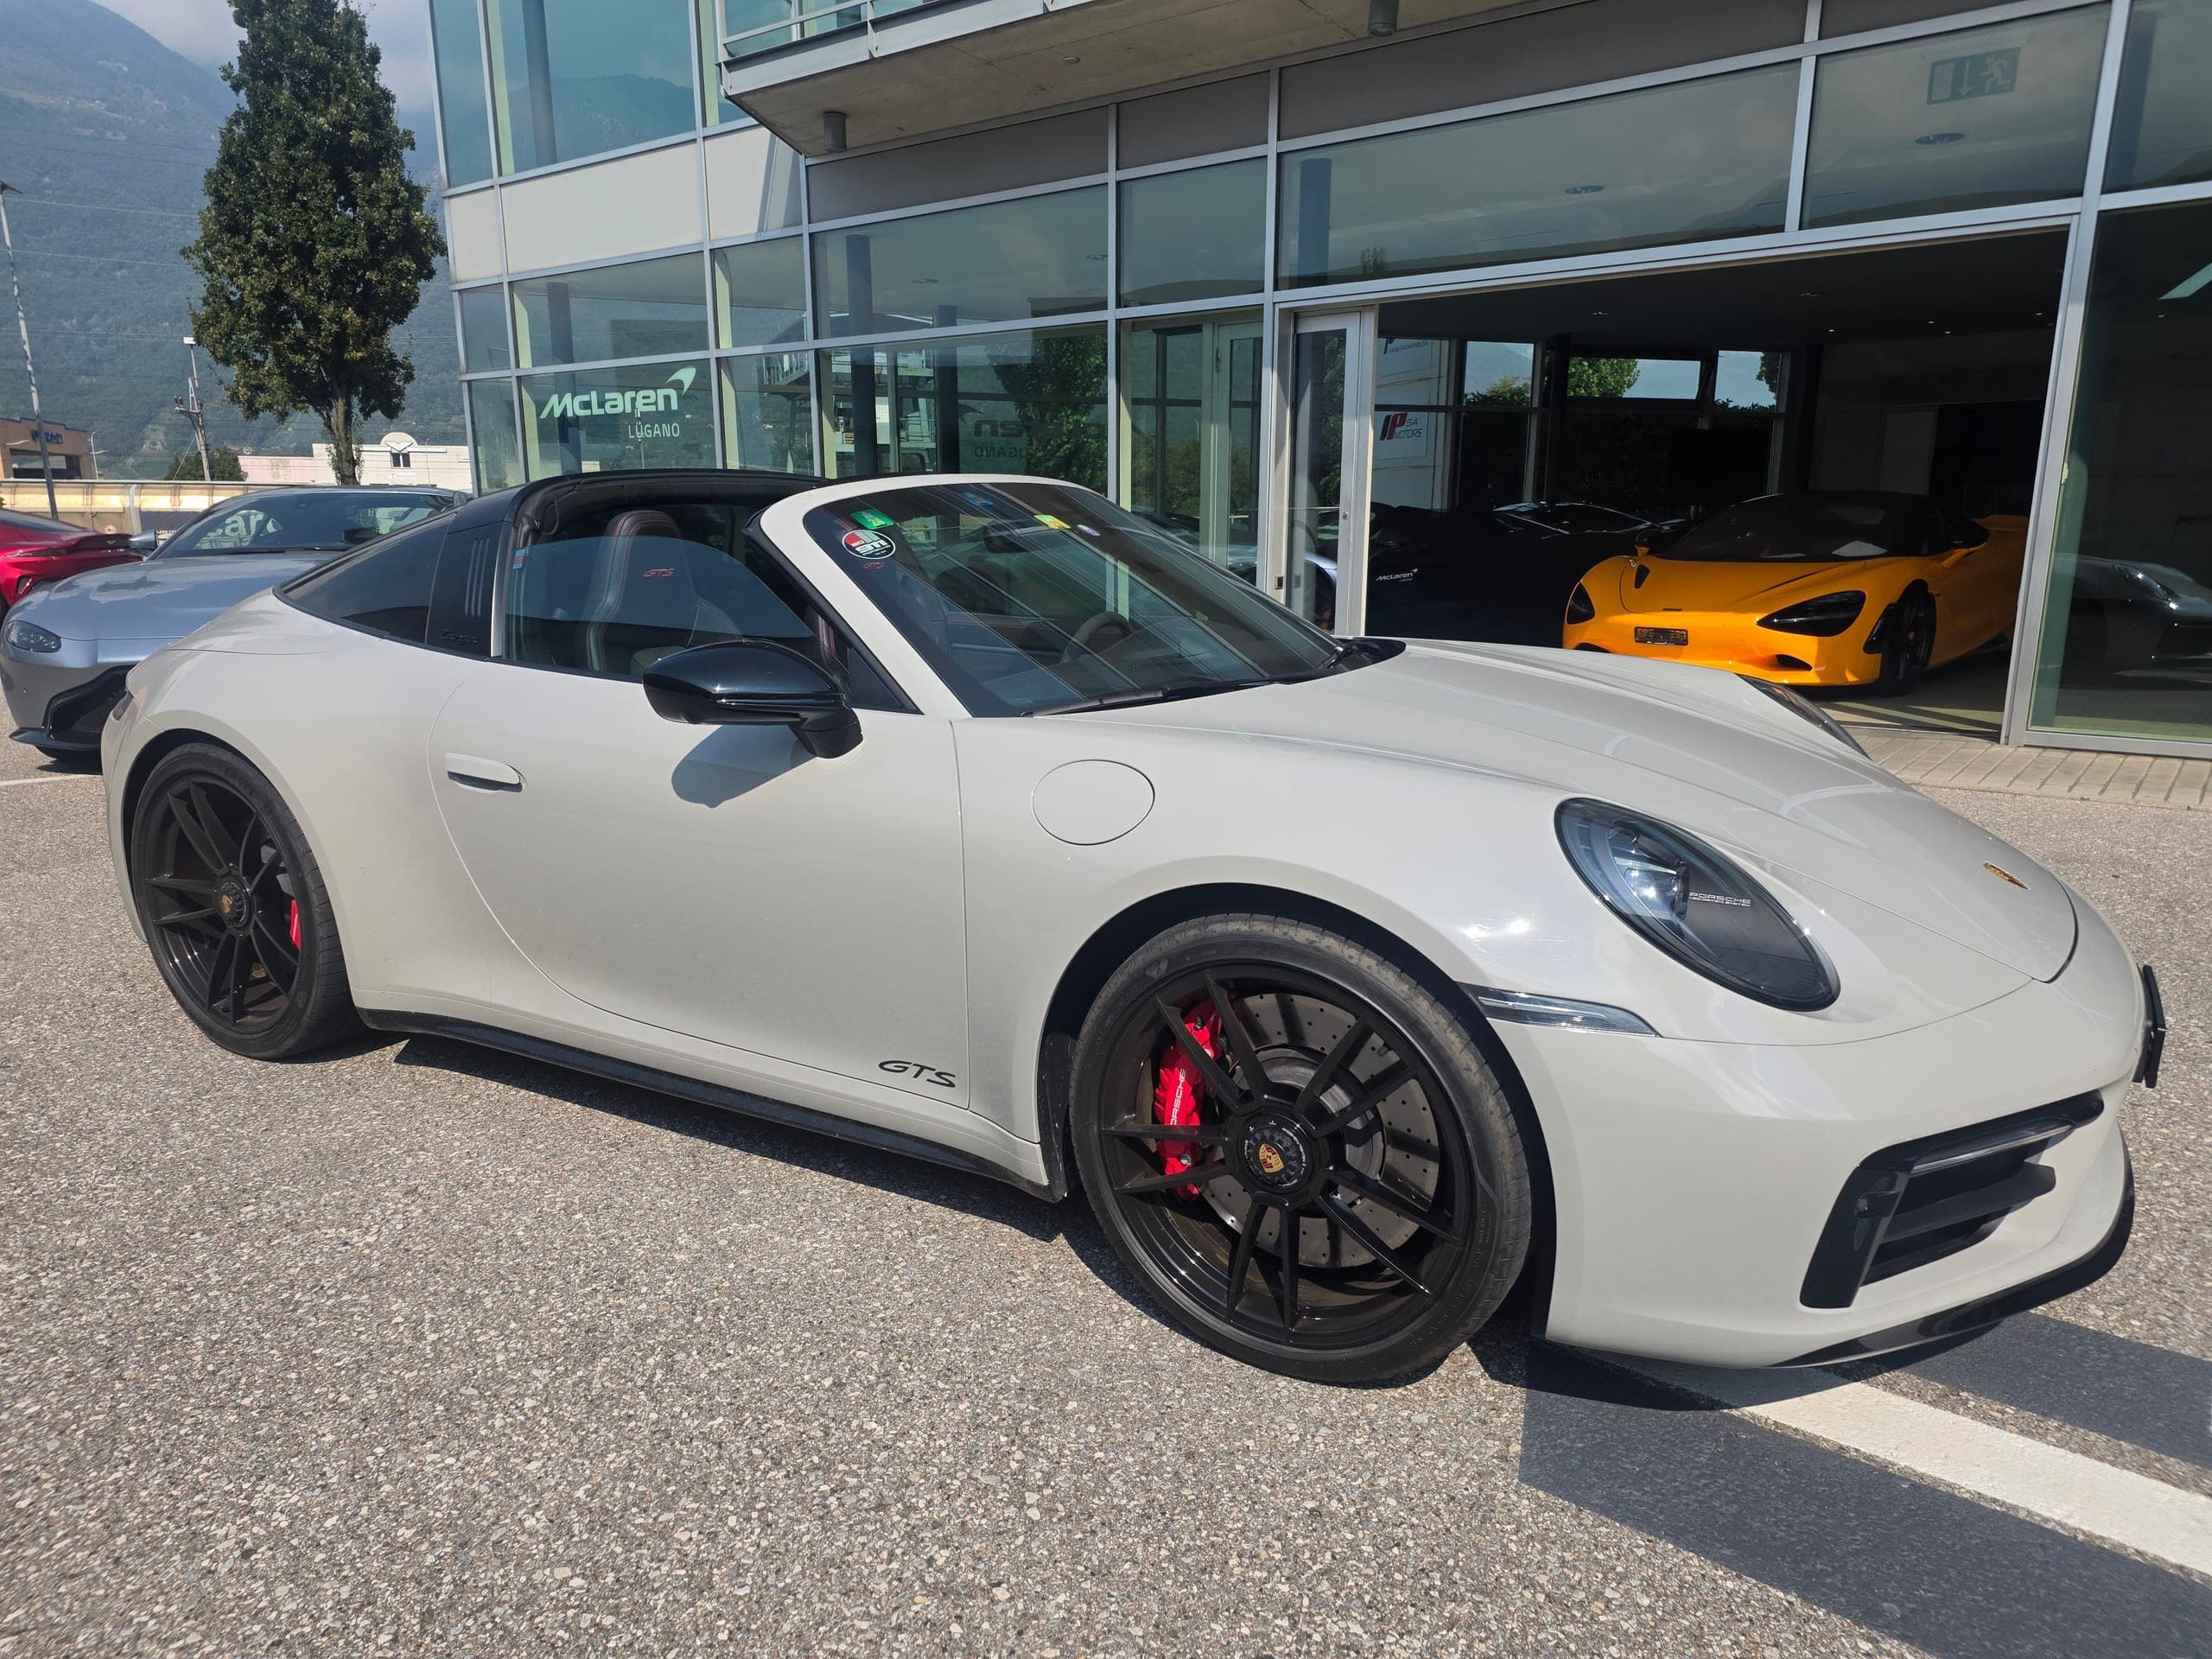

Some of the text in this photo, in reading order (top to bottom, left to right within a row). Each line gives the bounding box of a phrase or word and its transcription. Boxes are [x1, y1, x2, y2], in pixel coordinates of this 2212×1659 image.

[539, 389, 678, 419] McLaren
[628, 423, 680, 439] LUGANO
[643, 568, 675, 578] GTS
[1375, 572, 1414, 582] McLaren
[1689, 892, 1751, 905] PORSCHE
[878, 1060, 956, 1088] GTS
